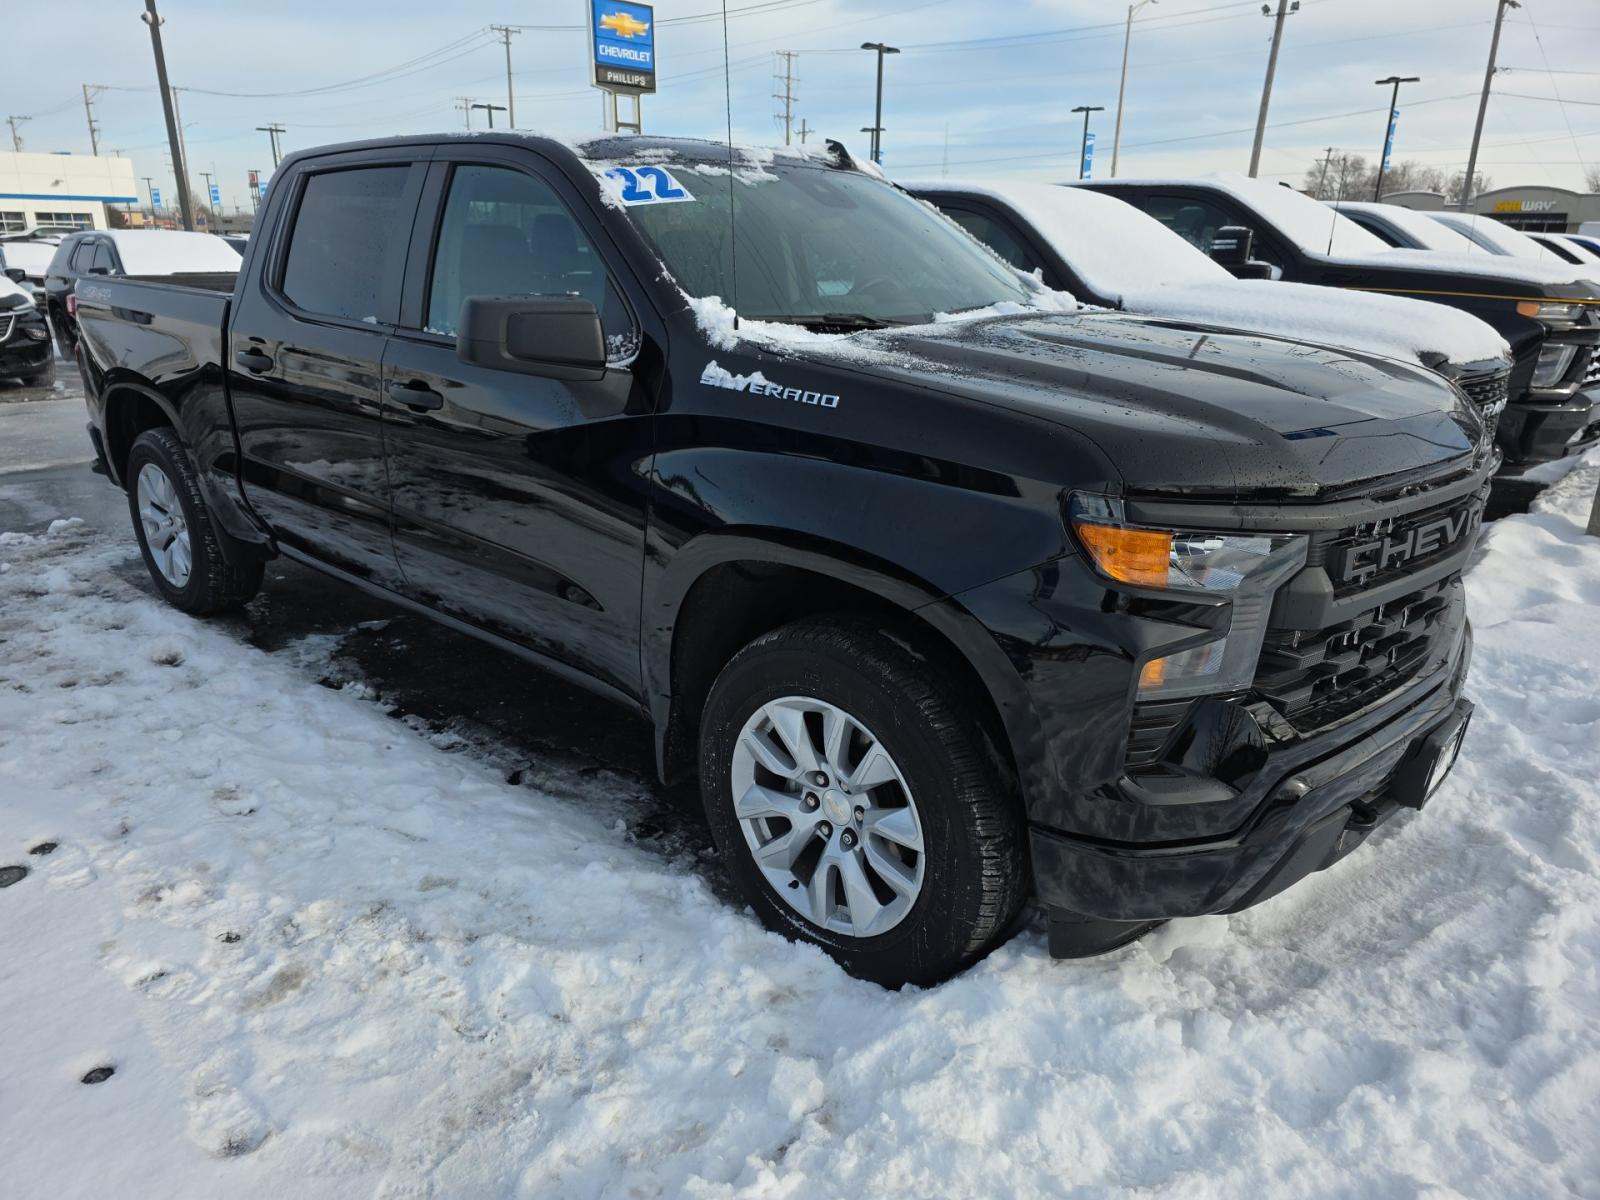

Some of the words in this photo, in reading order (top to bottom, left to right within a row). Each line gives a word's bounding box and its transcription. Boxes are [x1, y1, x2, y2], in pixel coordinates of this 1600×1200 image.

[599, 45, 651, 62] CHEVROLET
[608, 72, 646, 86] PHILLIPS
[605, 167, 685, 201] 22
